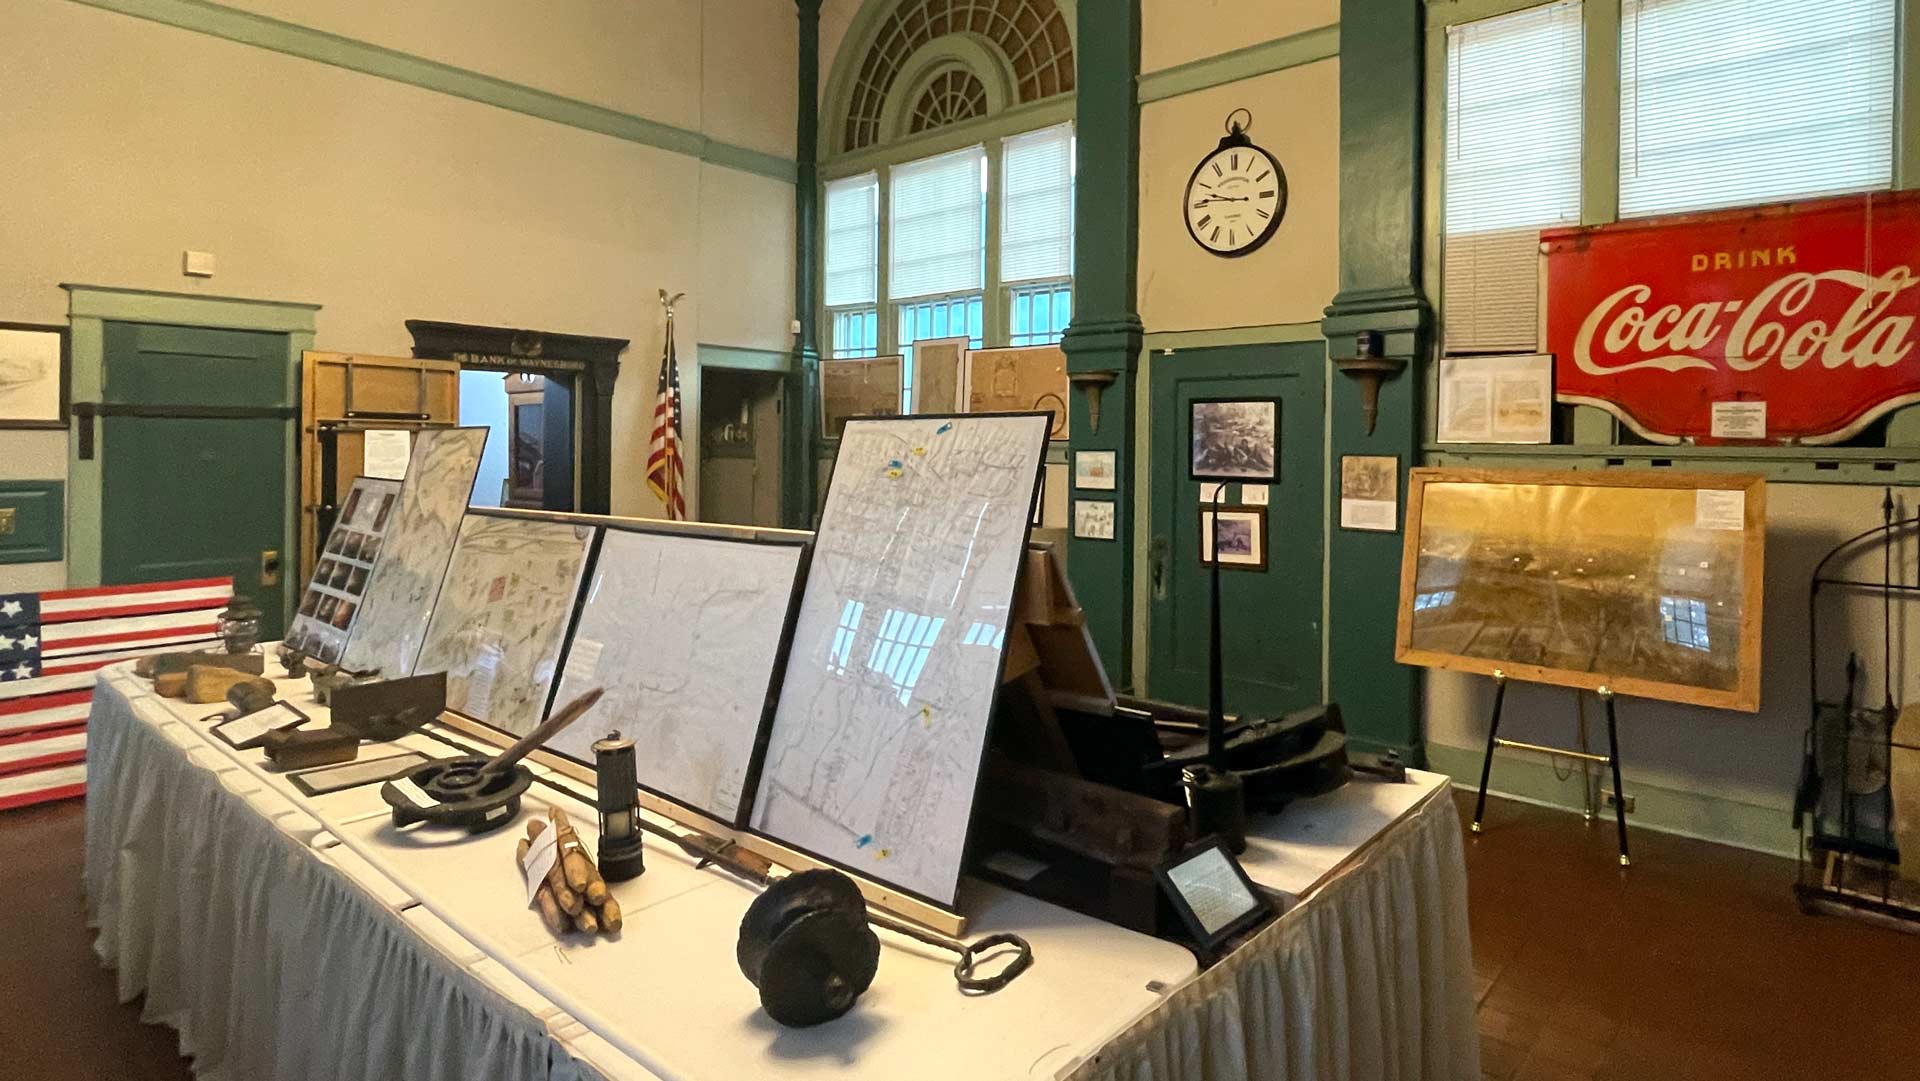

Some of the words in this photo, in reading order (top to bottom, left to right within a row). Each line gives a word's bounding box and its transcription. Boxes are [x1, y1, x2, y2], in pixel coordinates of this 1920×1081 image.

[1691, 246, 1797, 272] DRINK
[1573, 265, 1920, 376] Coca-Cola
[471, 354, 507, 365] BANK
